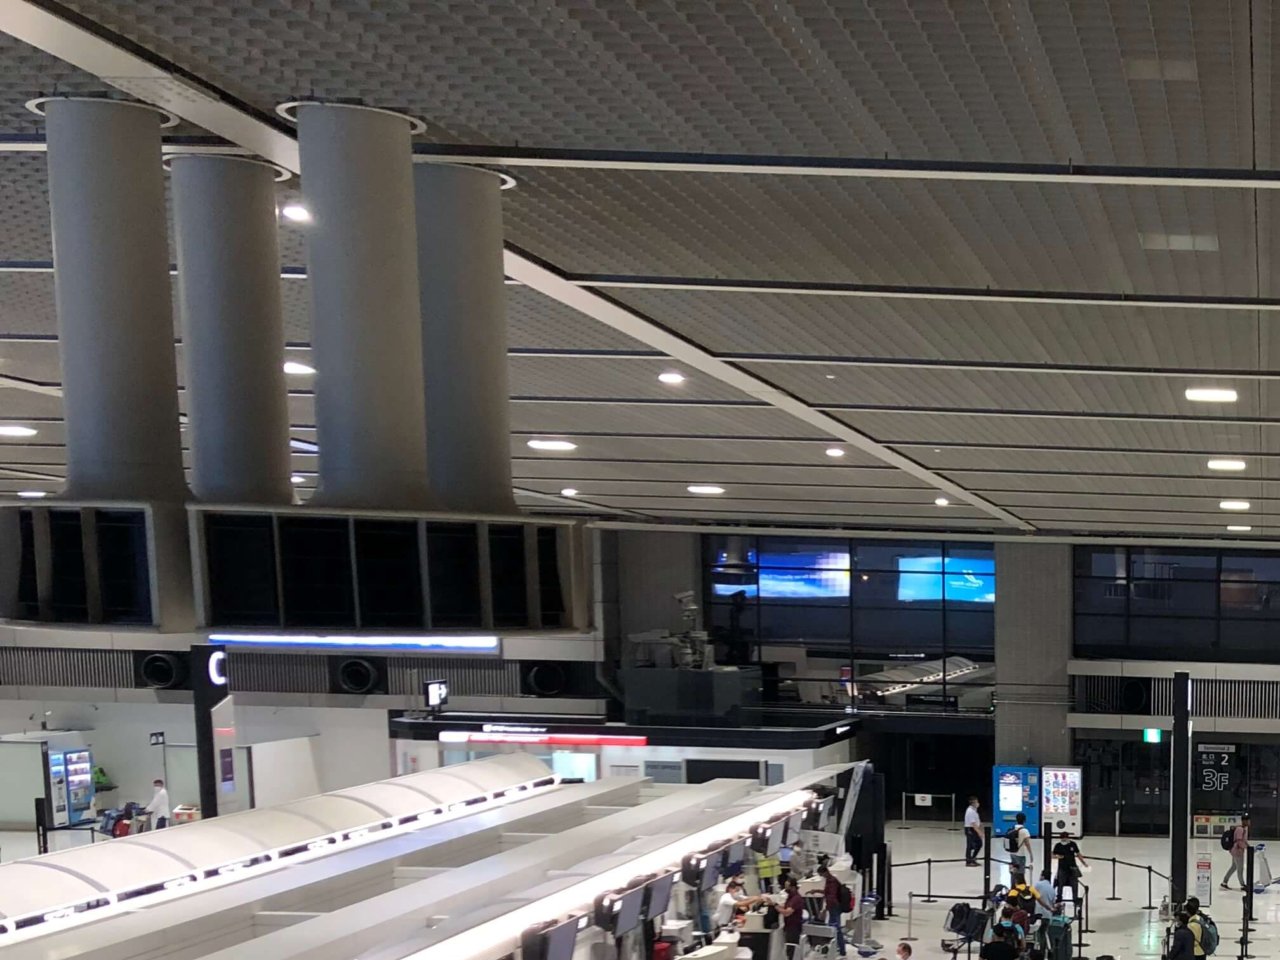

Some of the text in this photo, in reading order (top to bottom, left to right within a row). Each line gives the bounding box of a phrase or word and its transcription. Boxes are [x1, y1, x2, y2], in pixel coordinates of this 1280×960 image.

[208, 651, 227, 685] C
[1221, 754, 1229, 765] 2
[1202, 768, 1229, 791] 3F
